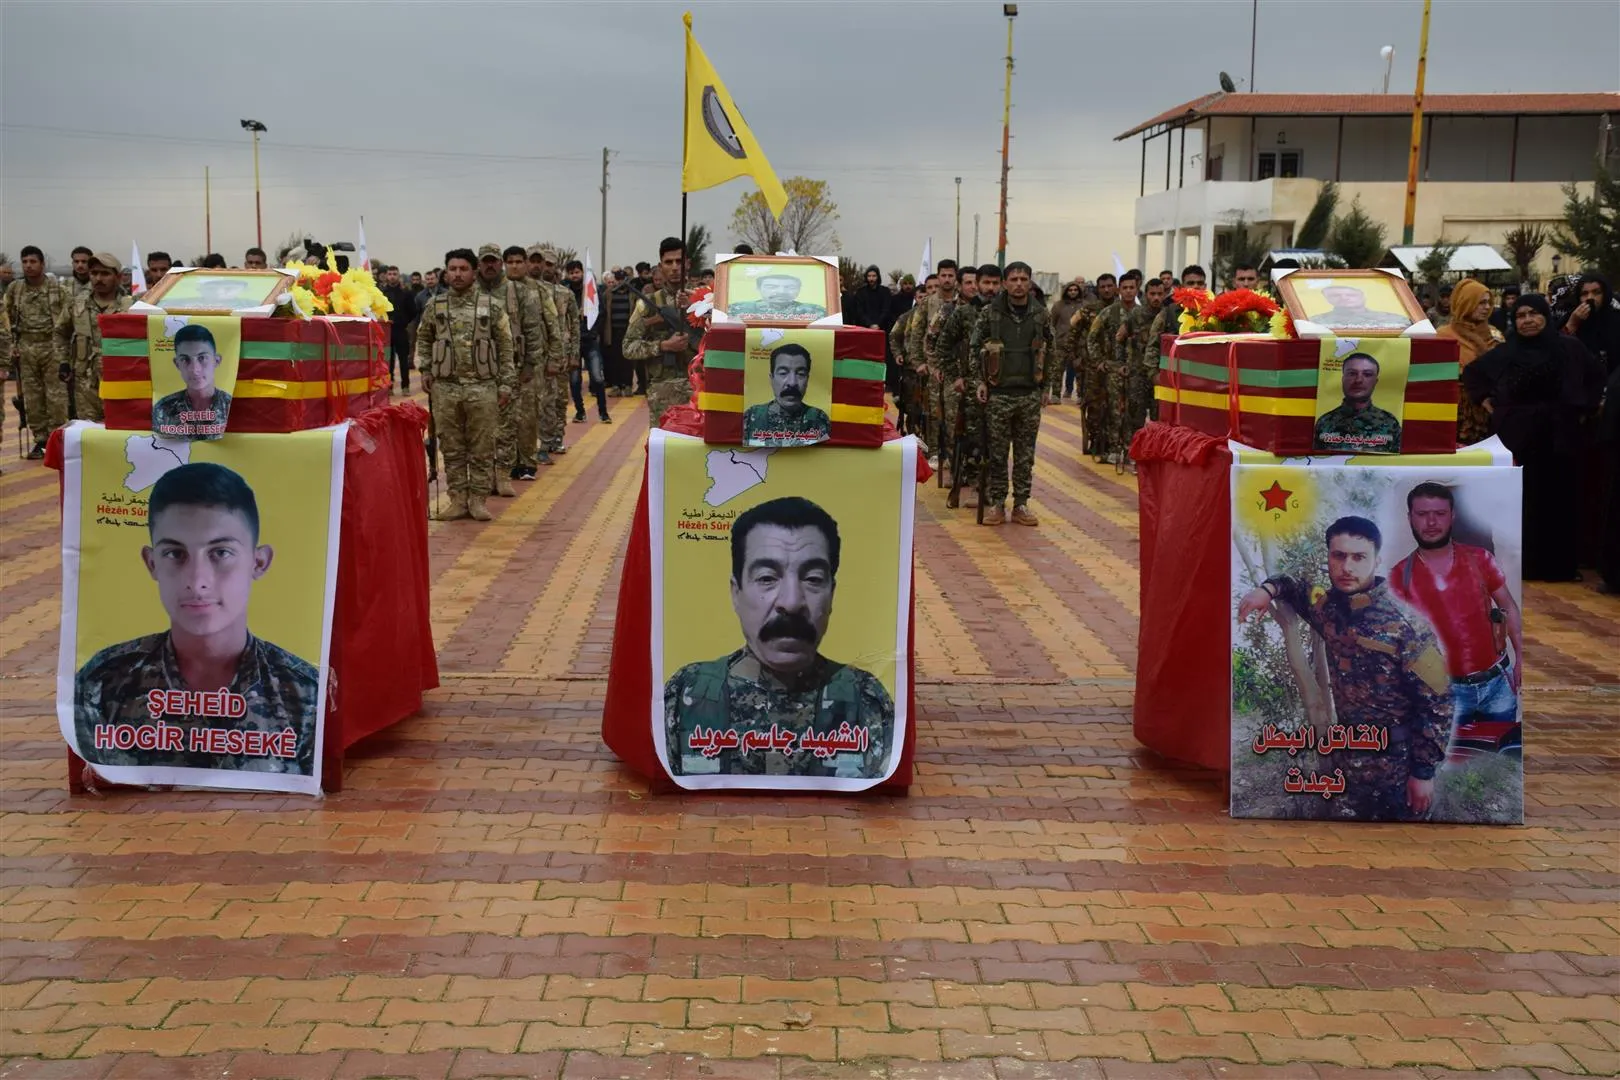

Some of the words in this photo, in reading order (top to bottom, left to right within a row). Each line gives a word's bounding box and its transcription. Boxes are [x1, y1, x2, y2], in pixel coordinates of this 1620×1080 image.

[131, 506, 149, 517] Sûr
[1256, 500, 1265, 511] Y
[1274, 512, 1281, 521] P
[1291, 499, 1299, 509] G
[148, 687, 246, 719] ŞEHEÎD
[189, 727, 297, 758] HESEKÊ
[689, 724, 739, 758] عويد
[742, 723, 798, 757] جاسم
[800, 721, 869, 758] الشهيد
[1252, 724, 1316, 755] البطل
[1318, 724, 1389, 755] المقاتل
[1284, 767, 1346, 799] نجدت
